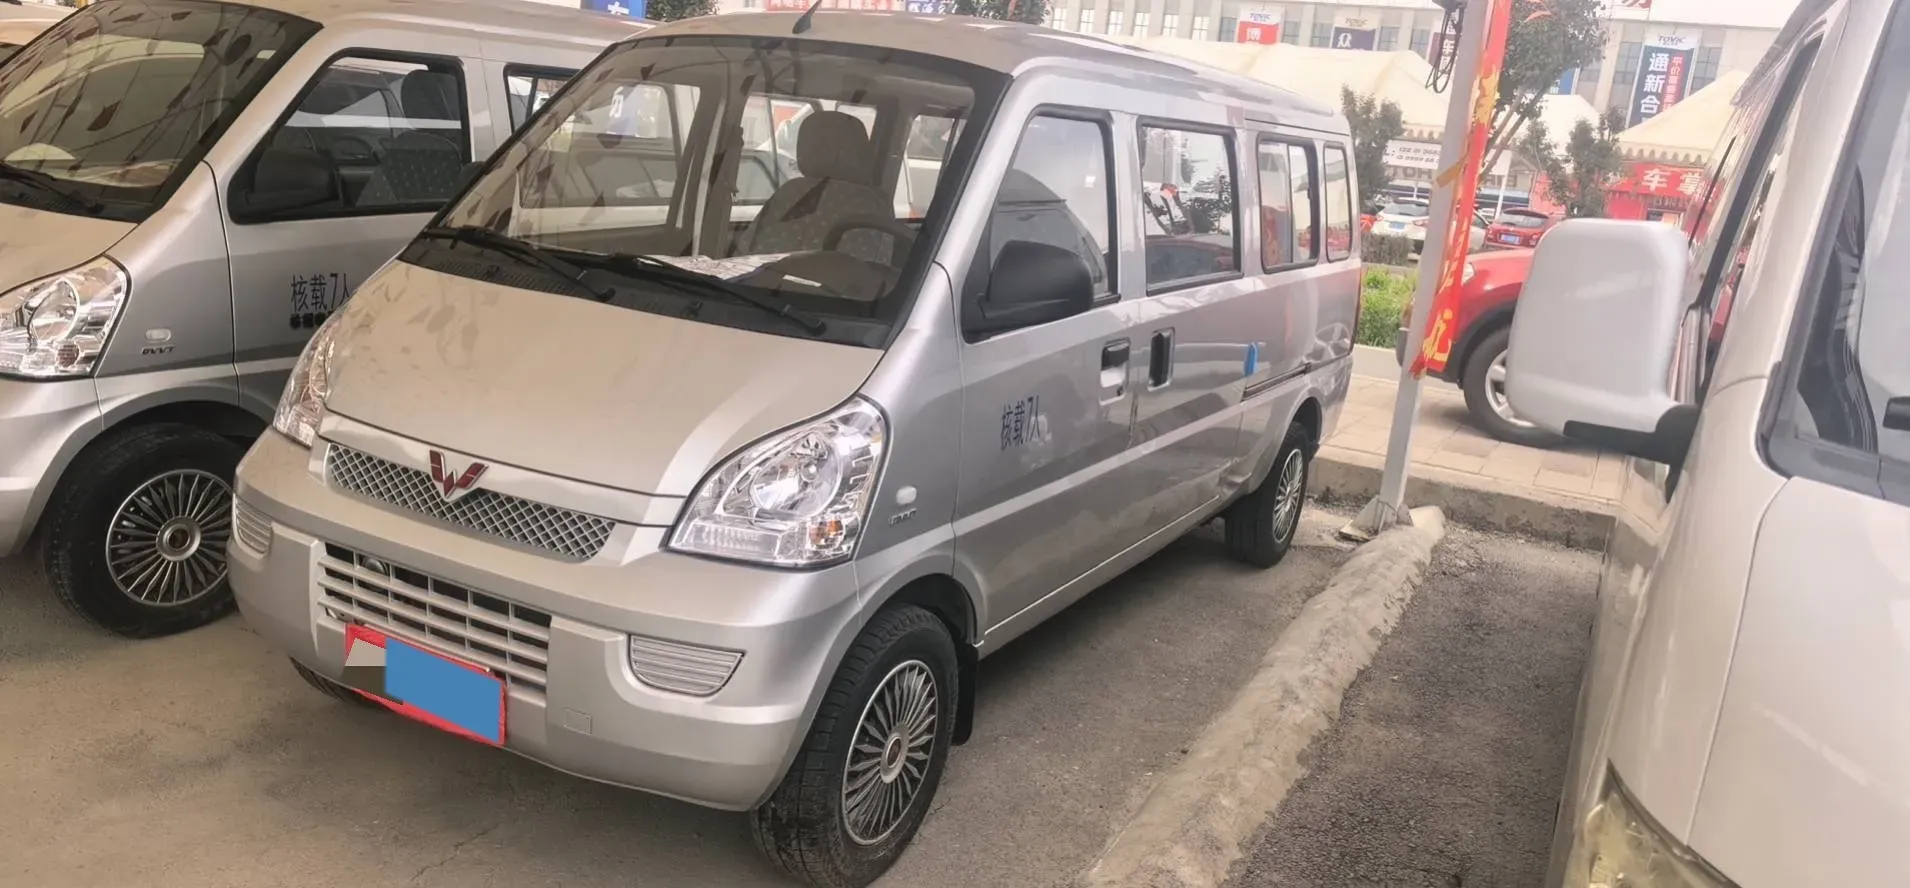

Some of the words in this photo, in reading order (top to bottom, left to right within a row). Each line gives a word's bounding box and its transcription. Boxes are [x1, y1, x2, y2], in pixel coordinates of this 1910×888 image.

[1640, 52, 1670, 122] 通新合
[290, 273, 350, 312] 核载7人
[1001, 395, 1040, 450] 核载7人
